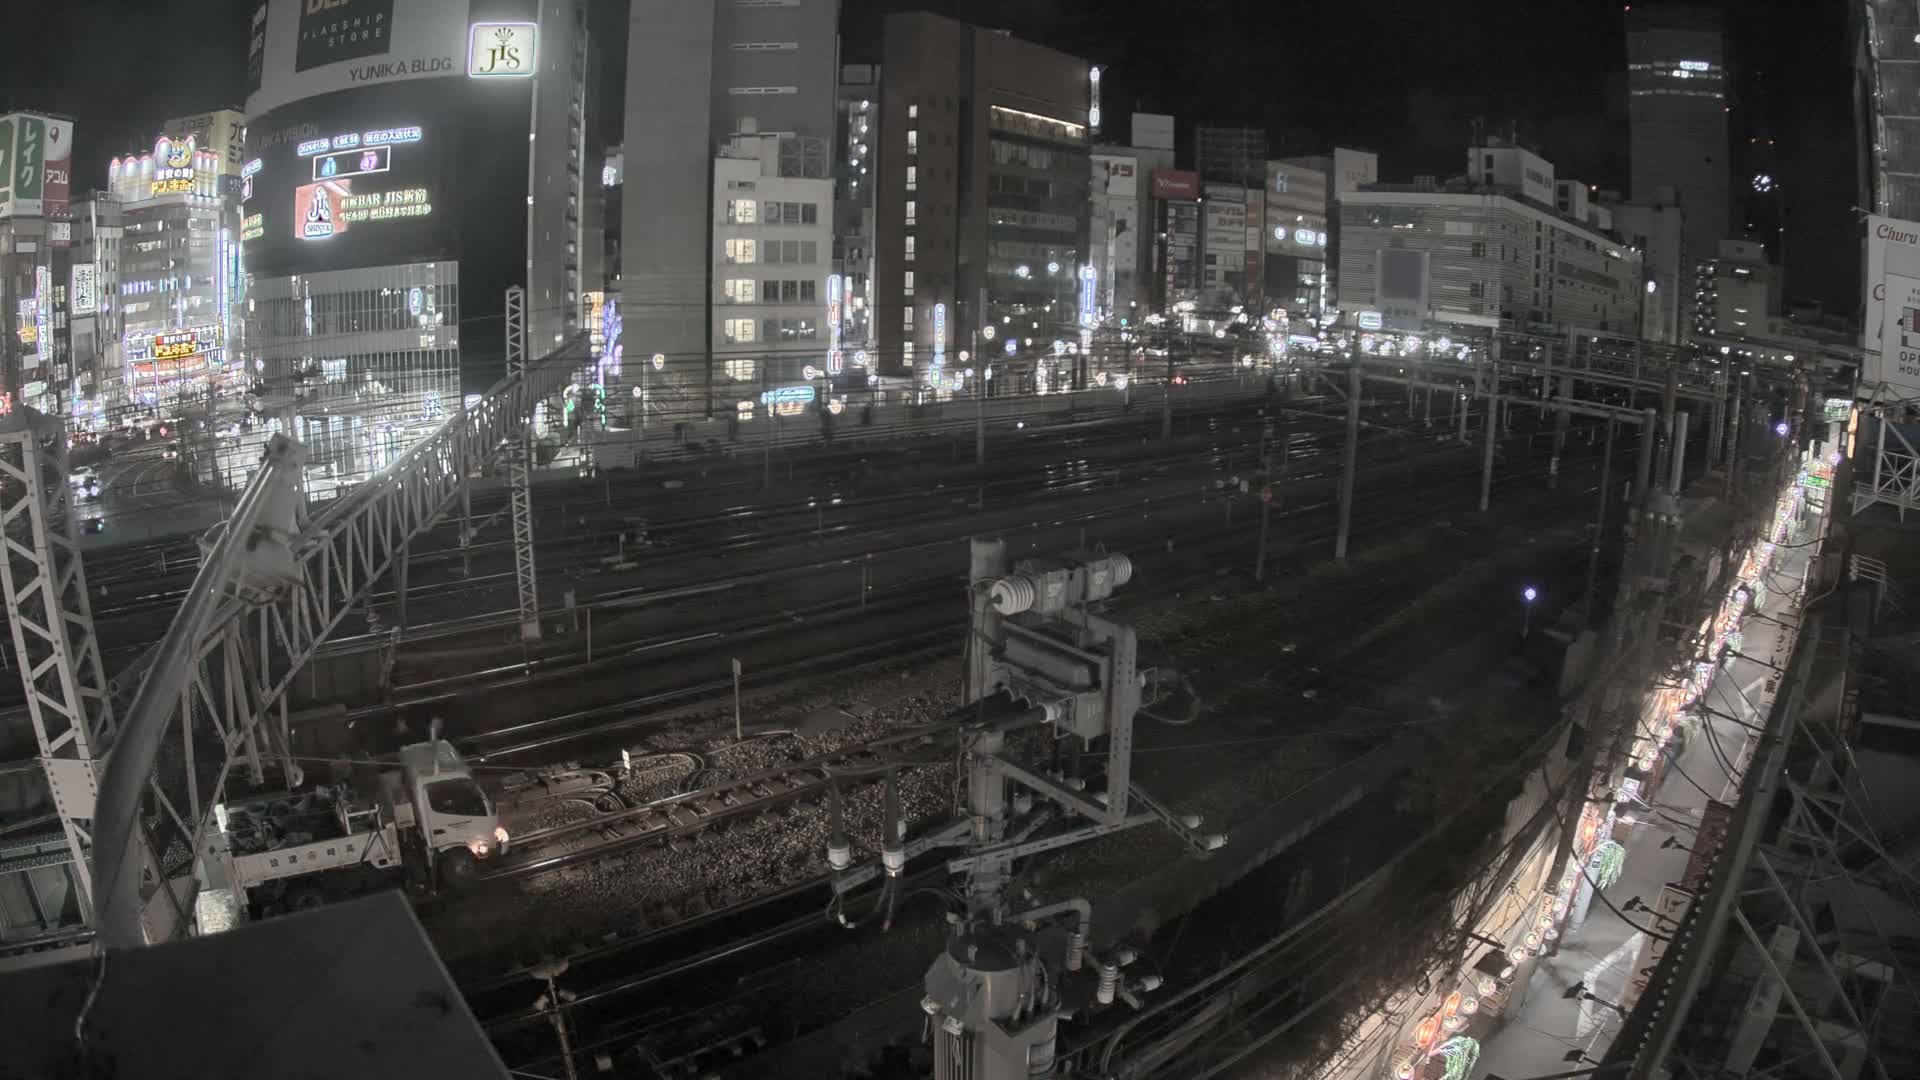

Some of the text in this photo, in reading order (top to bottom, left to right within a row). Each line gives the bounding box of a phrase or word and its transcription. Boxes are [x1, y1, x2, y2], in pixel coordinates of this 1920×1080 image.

[303, 14, 384, 41] FLAGSHIP
[328, 27, 383, 48] STORE
[480, 45, 520, 73] JIS
[350, 60, 408, 82] YUNIKA
[21, 120, 36, 188] レイク
[46, 169, 68, 185] アコム
[1876, 224, 1919, 244] Churu
